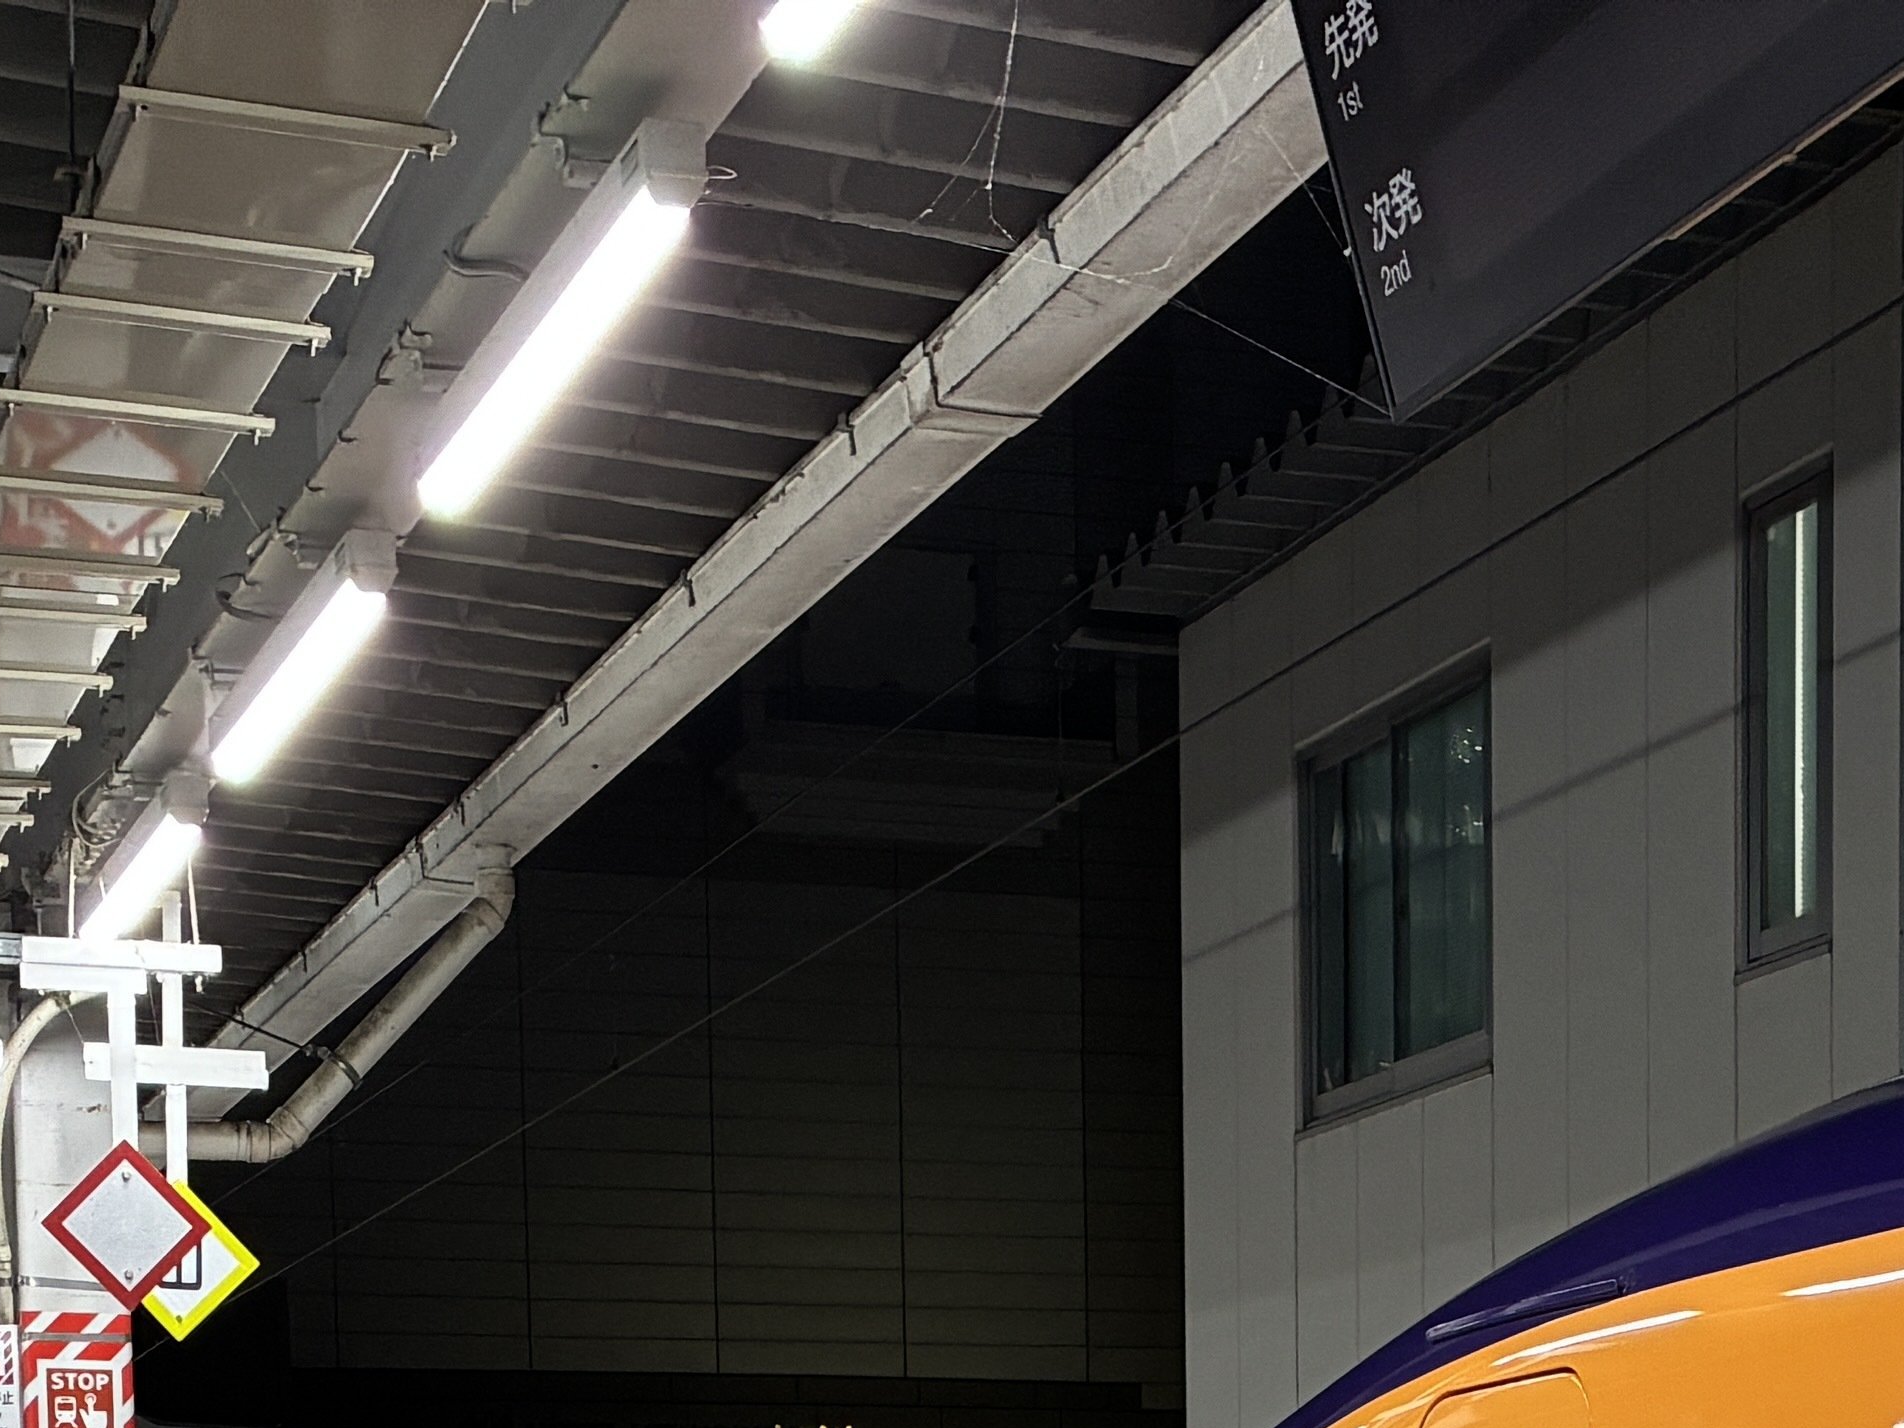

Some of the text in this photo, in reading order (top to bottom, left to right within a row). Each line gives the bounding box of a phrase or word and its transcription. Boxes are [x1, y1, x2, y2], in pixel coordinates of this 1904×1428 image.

[1324, 0, 1379, 80] 先発
[1338, 81, 1364, 121] 1st
[1364, 168, 1424, 252] 次発
[1380, 249, 1413, 297] 2nd
[51, 1372, 110, 1391] STOP
